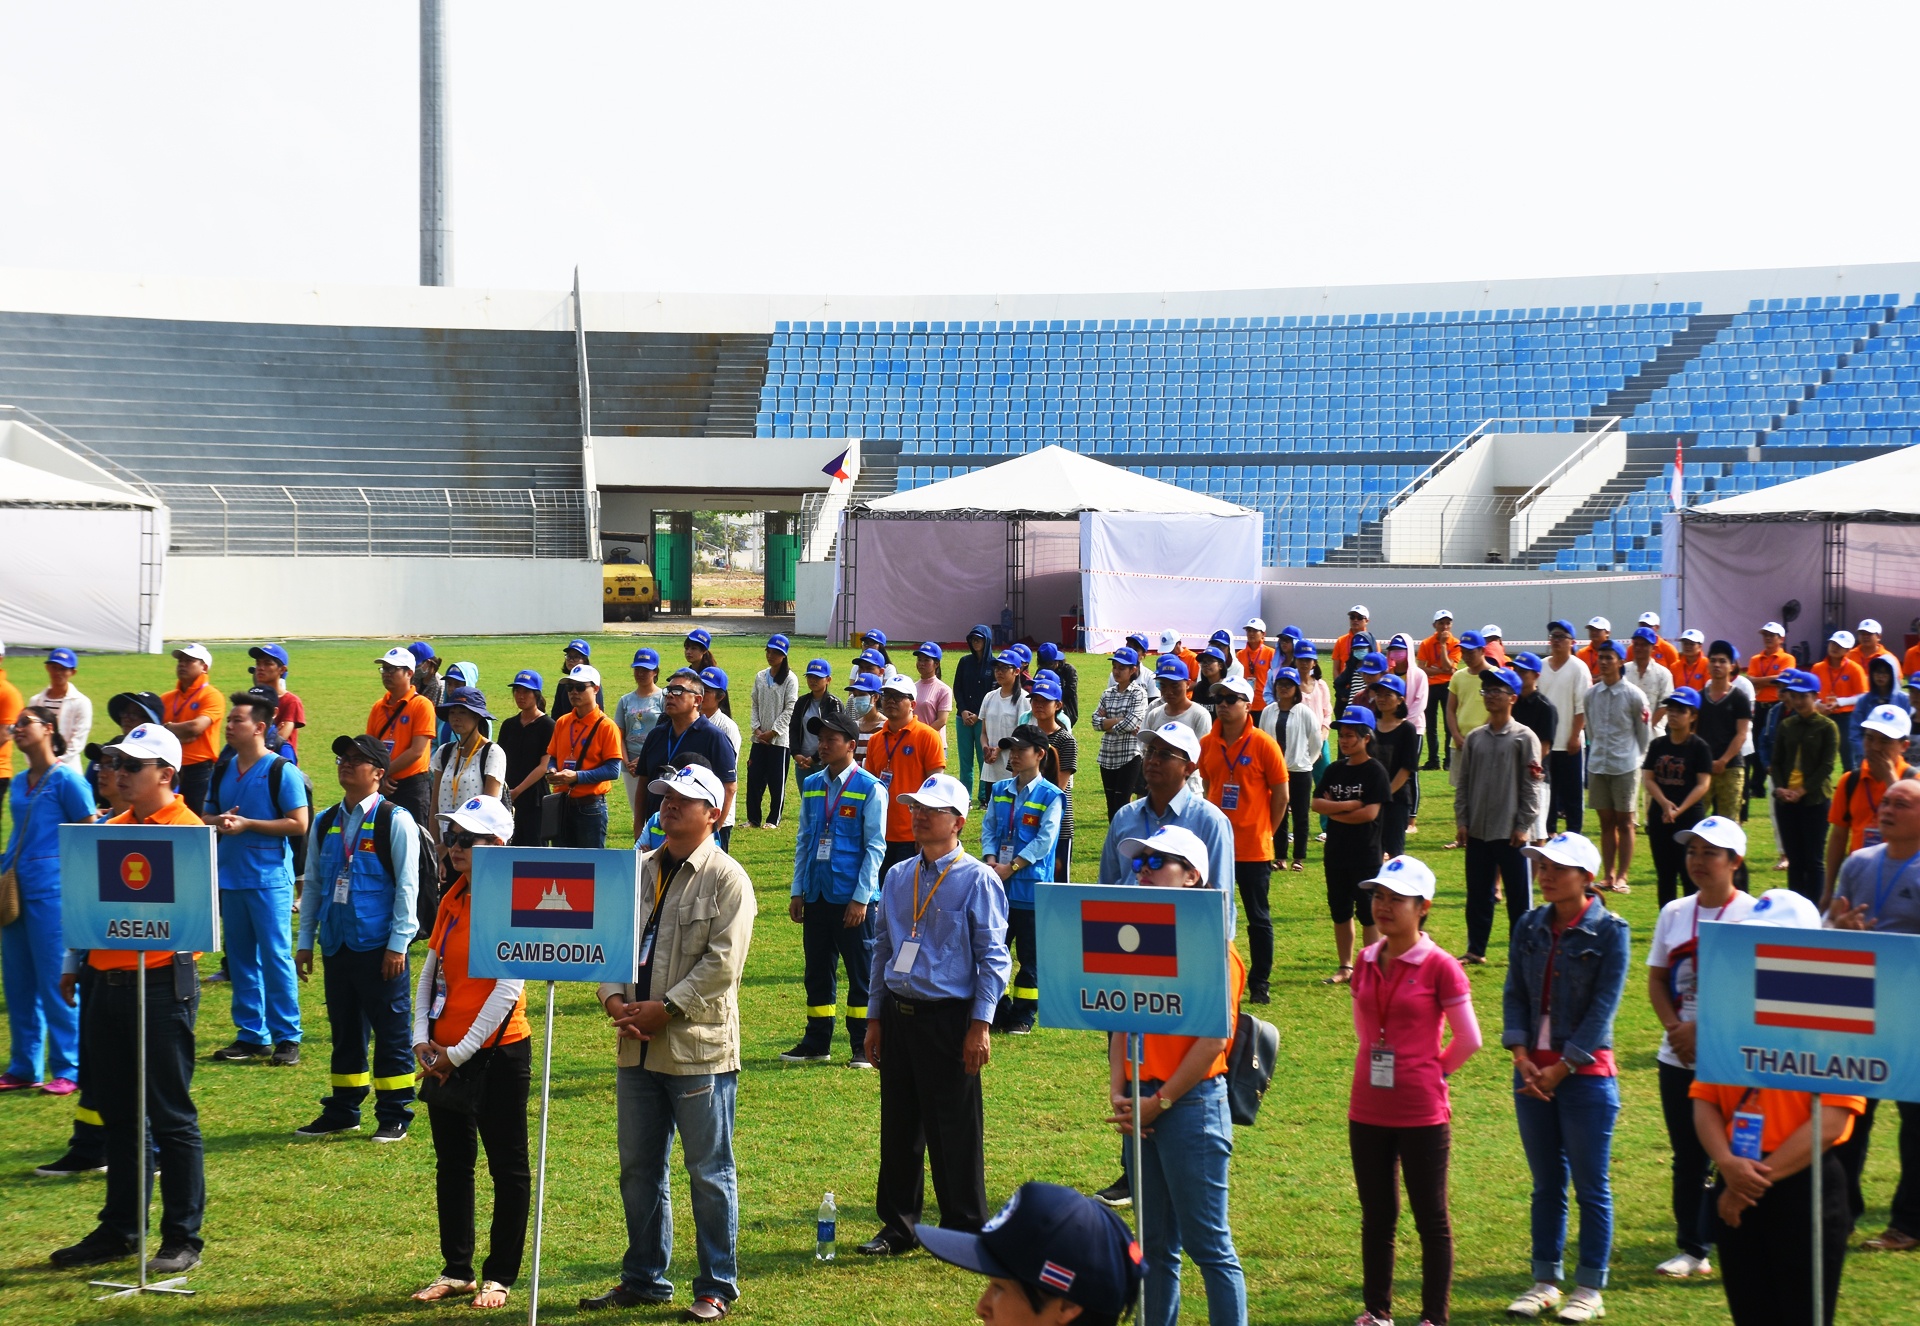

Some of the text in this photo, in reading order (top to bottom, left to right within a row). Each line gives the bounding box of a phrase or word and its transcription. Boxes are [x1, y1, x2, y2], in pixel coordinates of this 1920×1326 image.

[106, 919, 170, 939] ASEAN
[497, 941, 605, 965] CAMBODIA
[1081, 988, 1182, 1016] LAO PDR
[1740, 1046, 1889, 1084] THAILAND
